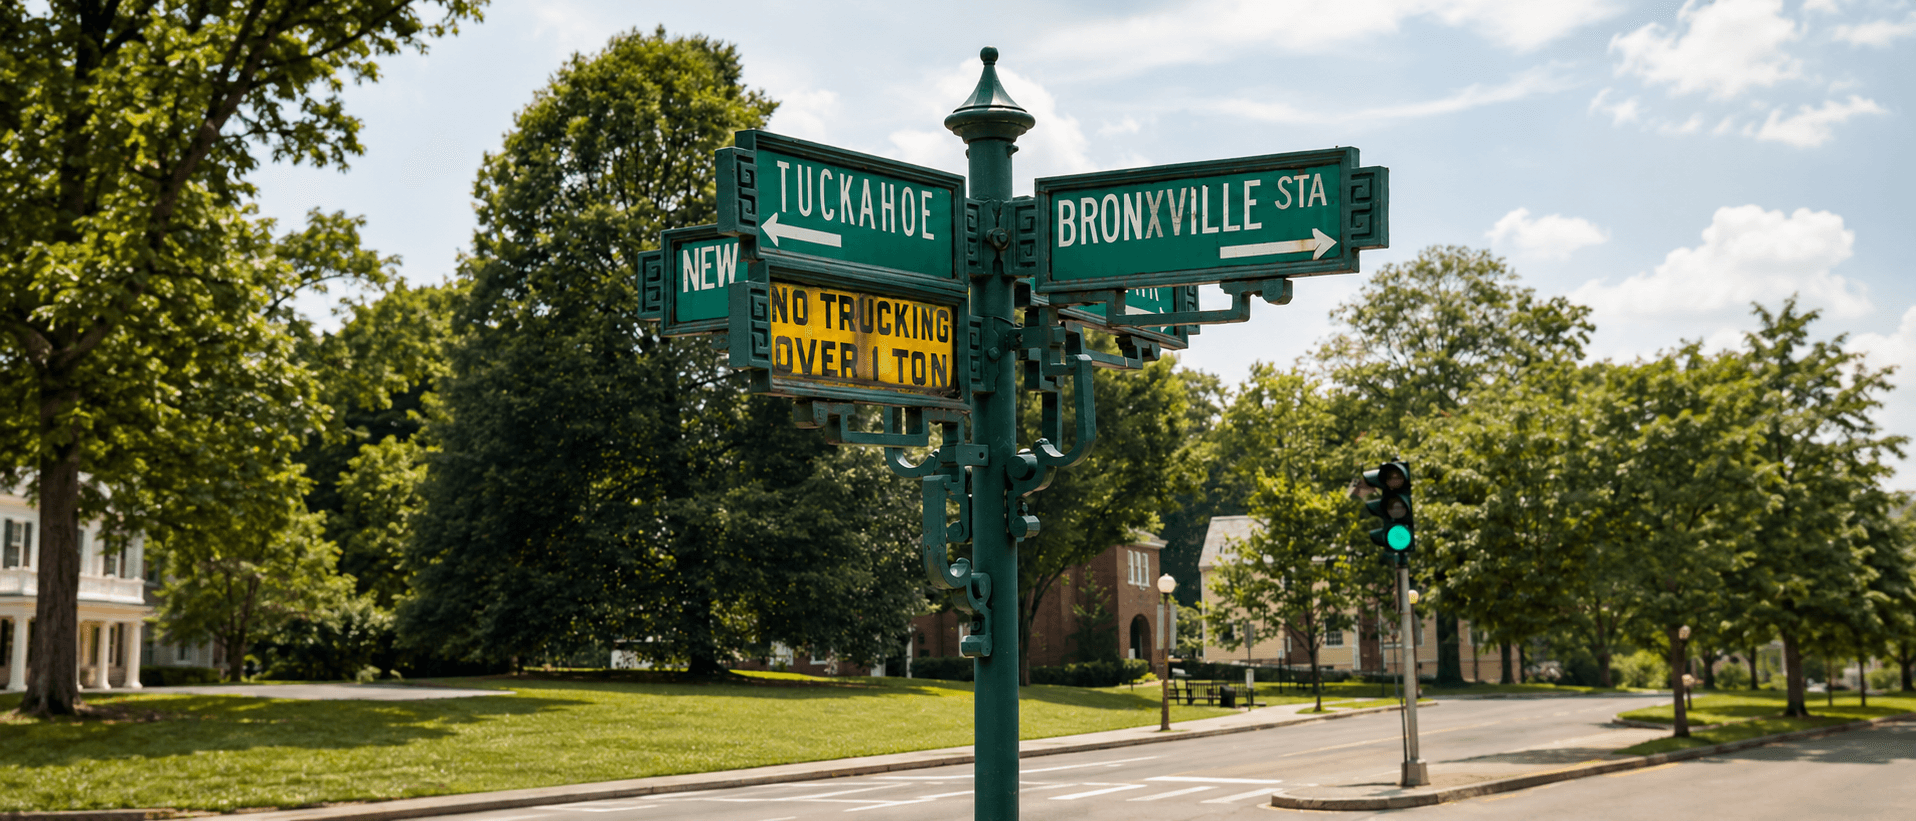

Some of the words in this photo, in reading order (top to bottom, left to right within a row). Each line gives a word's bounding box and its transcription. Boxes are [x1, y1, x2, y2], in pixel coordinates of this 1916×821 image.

[777, 160, 935, 240] TUCKAHOE
[1058, 179, 1262, 247] BRONXVILLE
[1275, 173, 1328, 210] STA
[683, 242, 739, 293] NEW
[771, 286, 809, 326] NO
[820, 293, 949, 343] TRUCKING
[775, 336, 858, 378] OVER
[892, 348, 948, 388] TON
